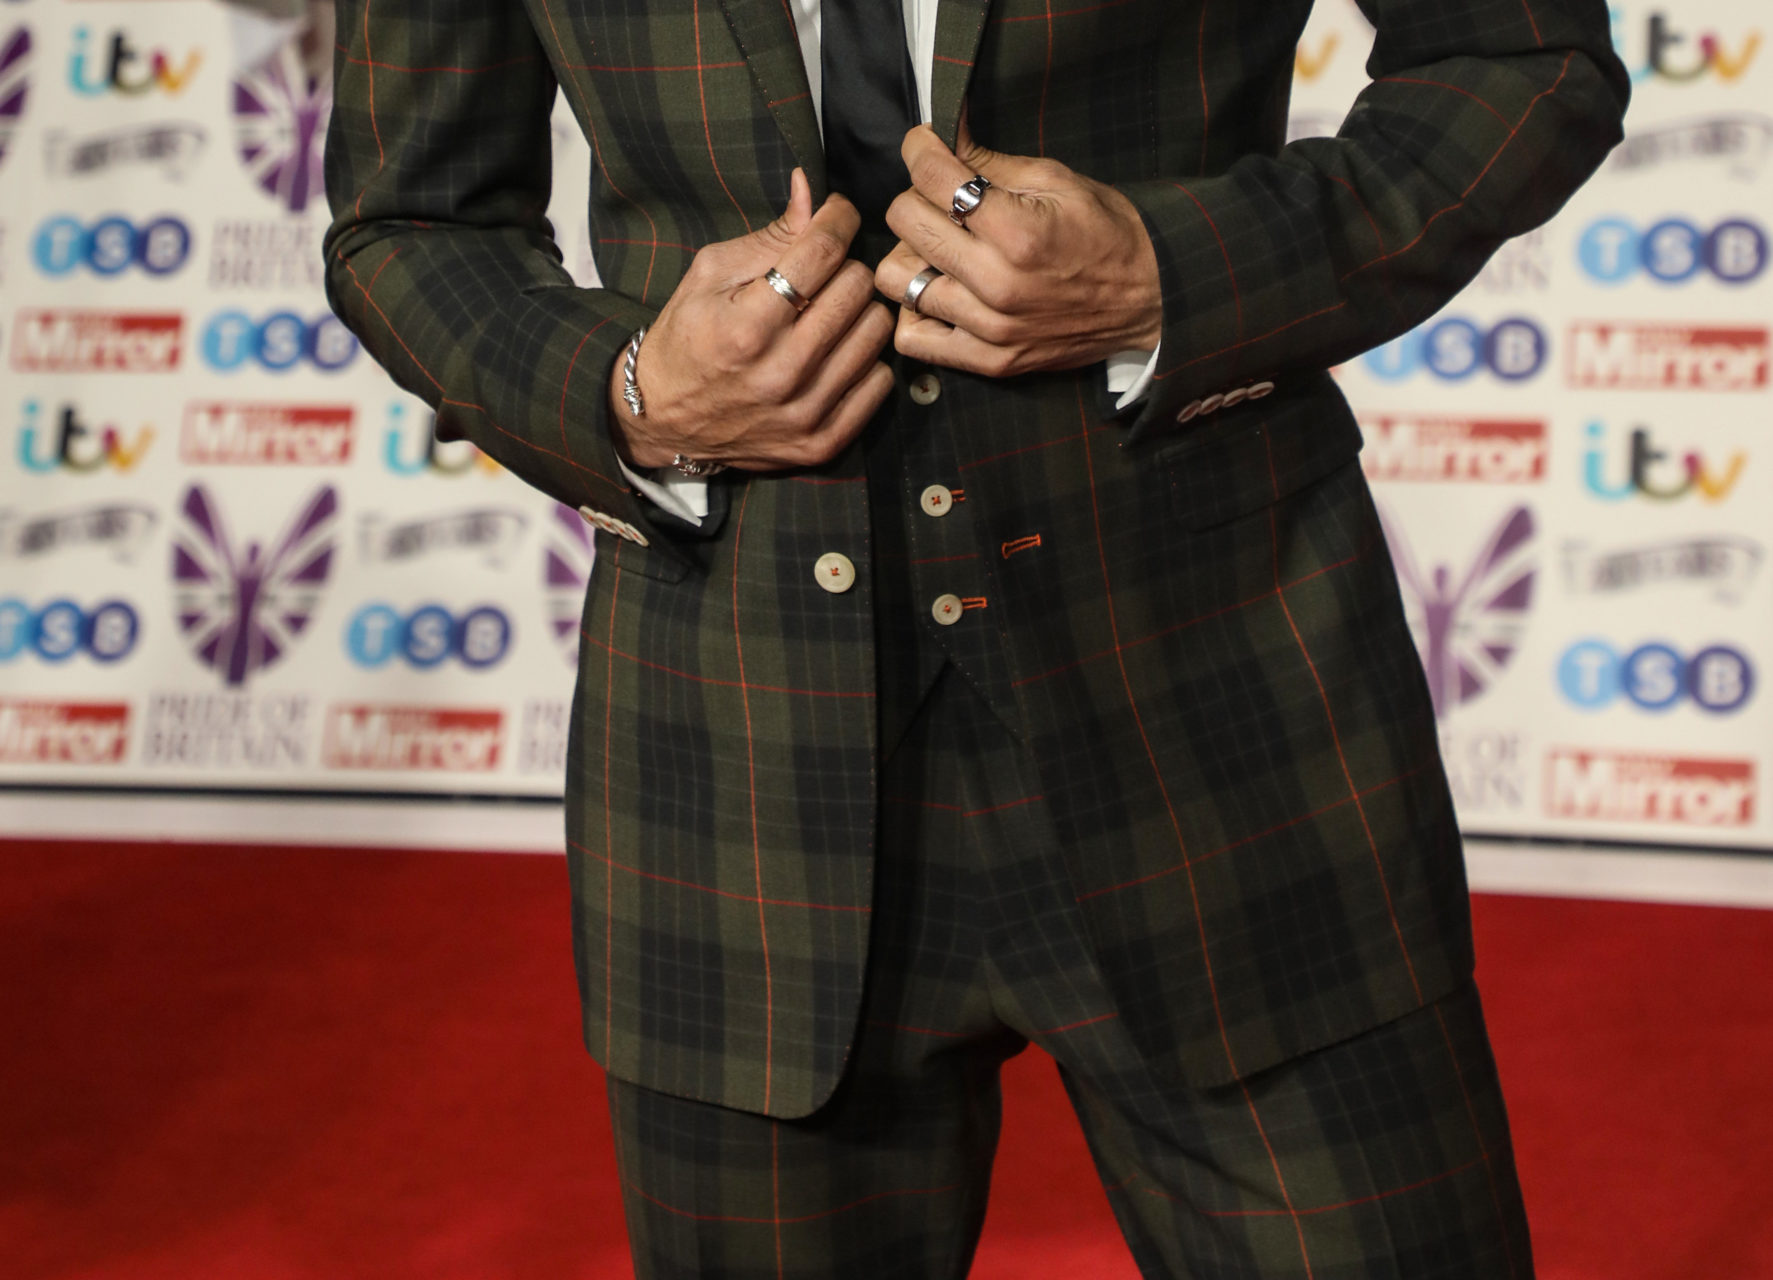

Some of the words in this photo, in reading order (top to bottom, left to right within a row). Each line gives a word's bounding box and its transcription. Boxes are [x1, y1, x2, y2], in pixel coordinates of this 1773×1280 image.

[66, 23, 204, 100] itv
[36, 220, 188, 274] TSB
[1585, 222, 1760, 280] TSB
[22, 311, 180, 368] Mirror
[203, 312, 352, 370] TSB
[1573, 326, 1765, 388] Mirror
[17, 397, 156, 476] itv
[190, 403, 352, 462] Mirror
[382, 399, 504, 478] it
[1359, 419, 1545, 480] Mirror
[1582, 419, 1747, 504] itv
[353, 606, 507, 666] TSB
[1568, 645, 1748, 708] TSB
[334, 709, 501, 767] Mirror
[1553, 755, 1754, 821] Mirror
